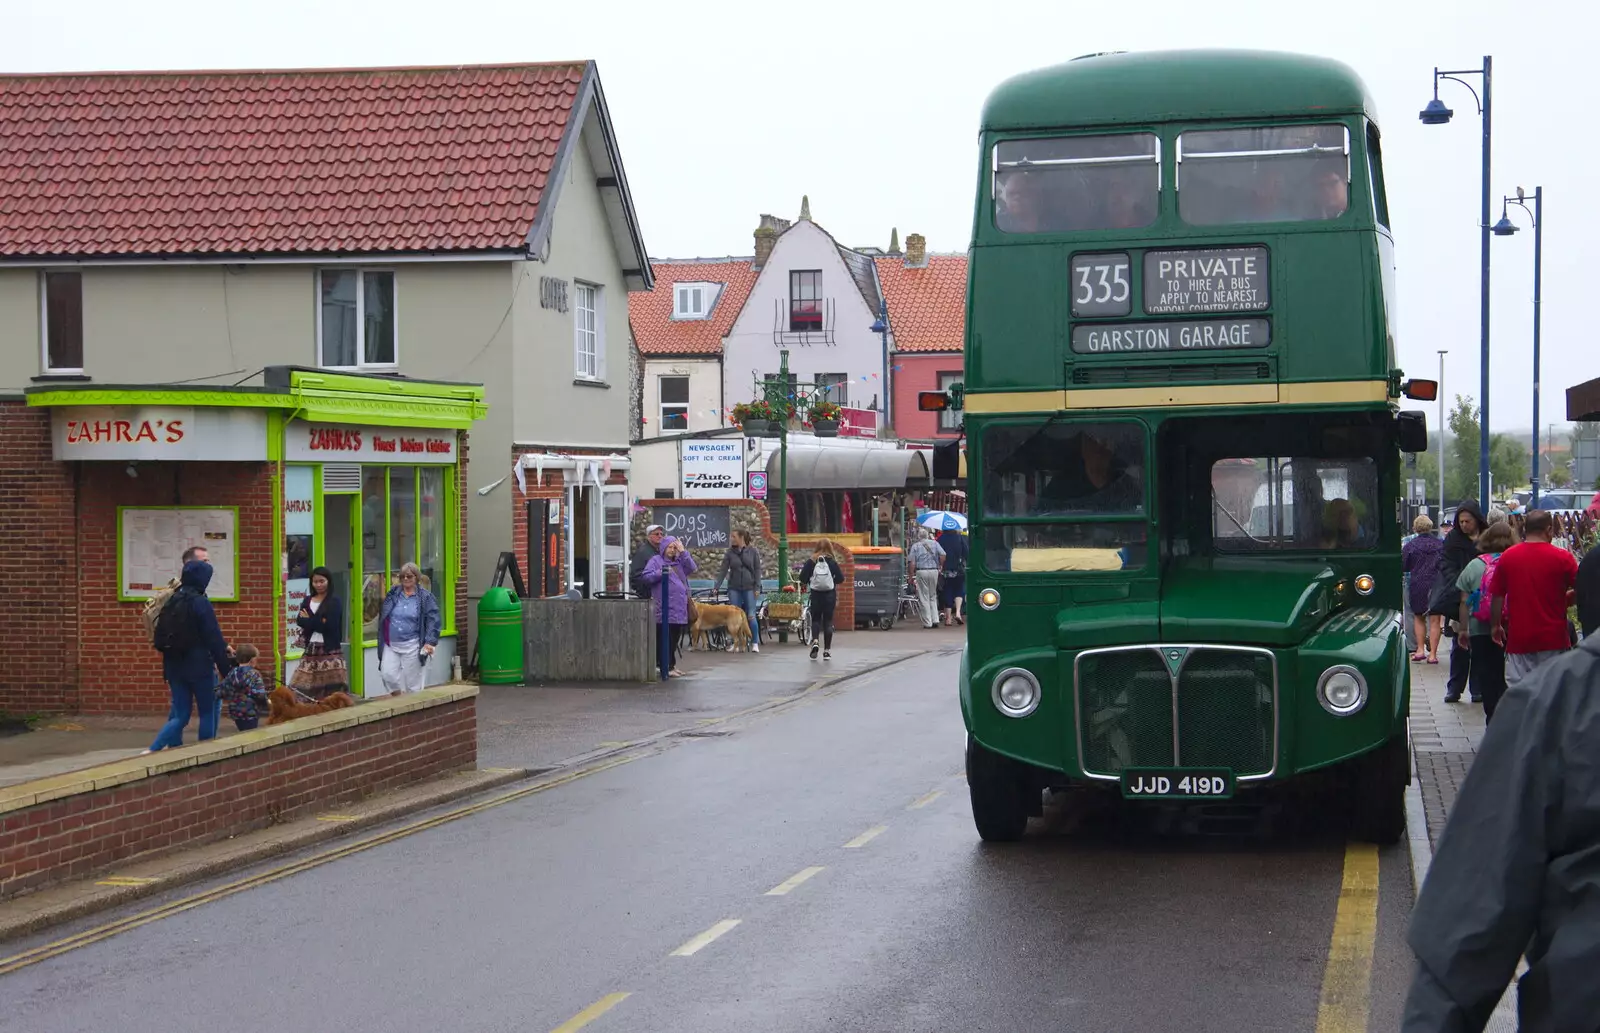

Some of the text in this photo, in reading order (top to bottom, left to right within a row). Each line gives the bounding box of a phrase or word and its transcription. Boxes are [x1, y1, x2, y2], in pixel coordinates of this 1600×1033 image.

[1159, 257, 1257, 279] PRIVATE
[1076, 264, 1130, 304] 335
[1167, 277, 1251, 292] TO HIRE A BUS
[1160, 290, 1257, 305] APPLY TO NEAREST
[1088, 324, 1251, 351] GARSTON GARAGE
[67, 419, 184, 442] ZAHRA'S
[310, 428, 362, 451] ZAHRA'S
[286, 500, 312, 513] AHRA'S
[1130, 776, 1225, 794] JJD 419D
